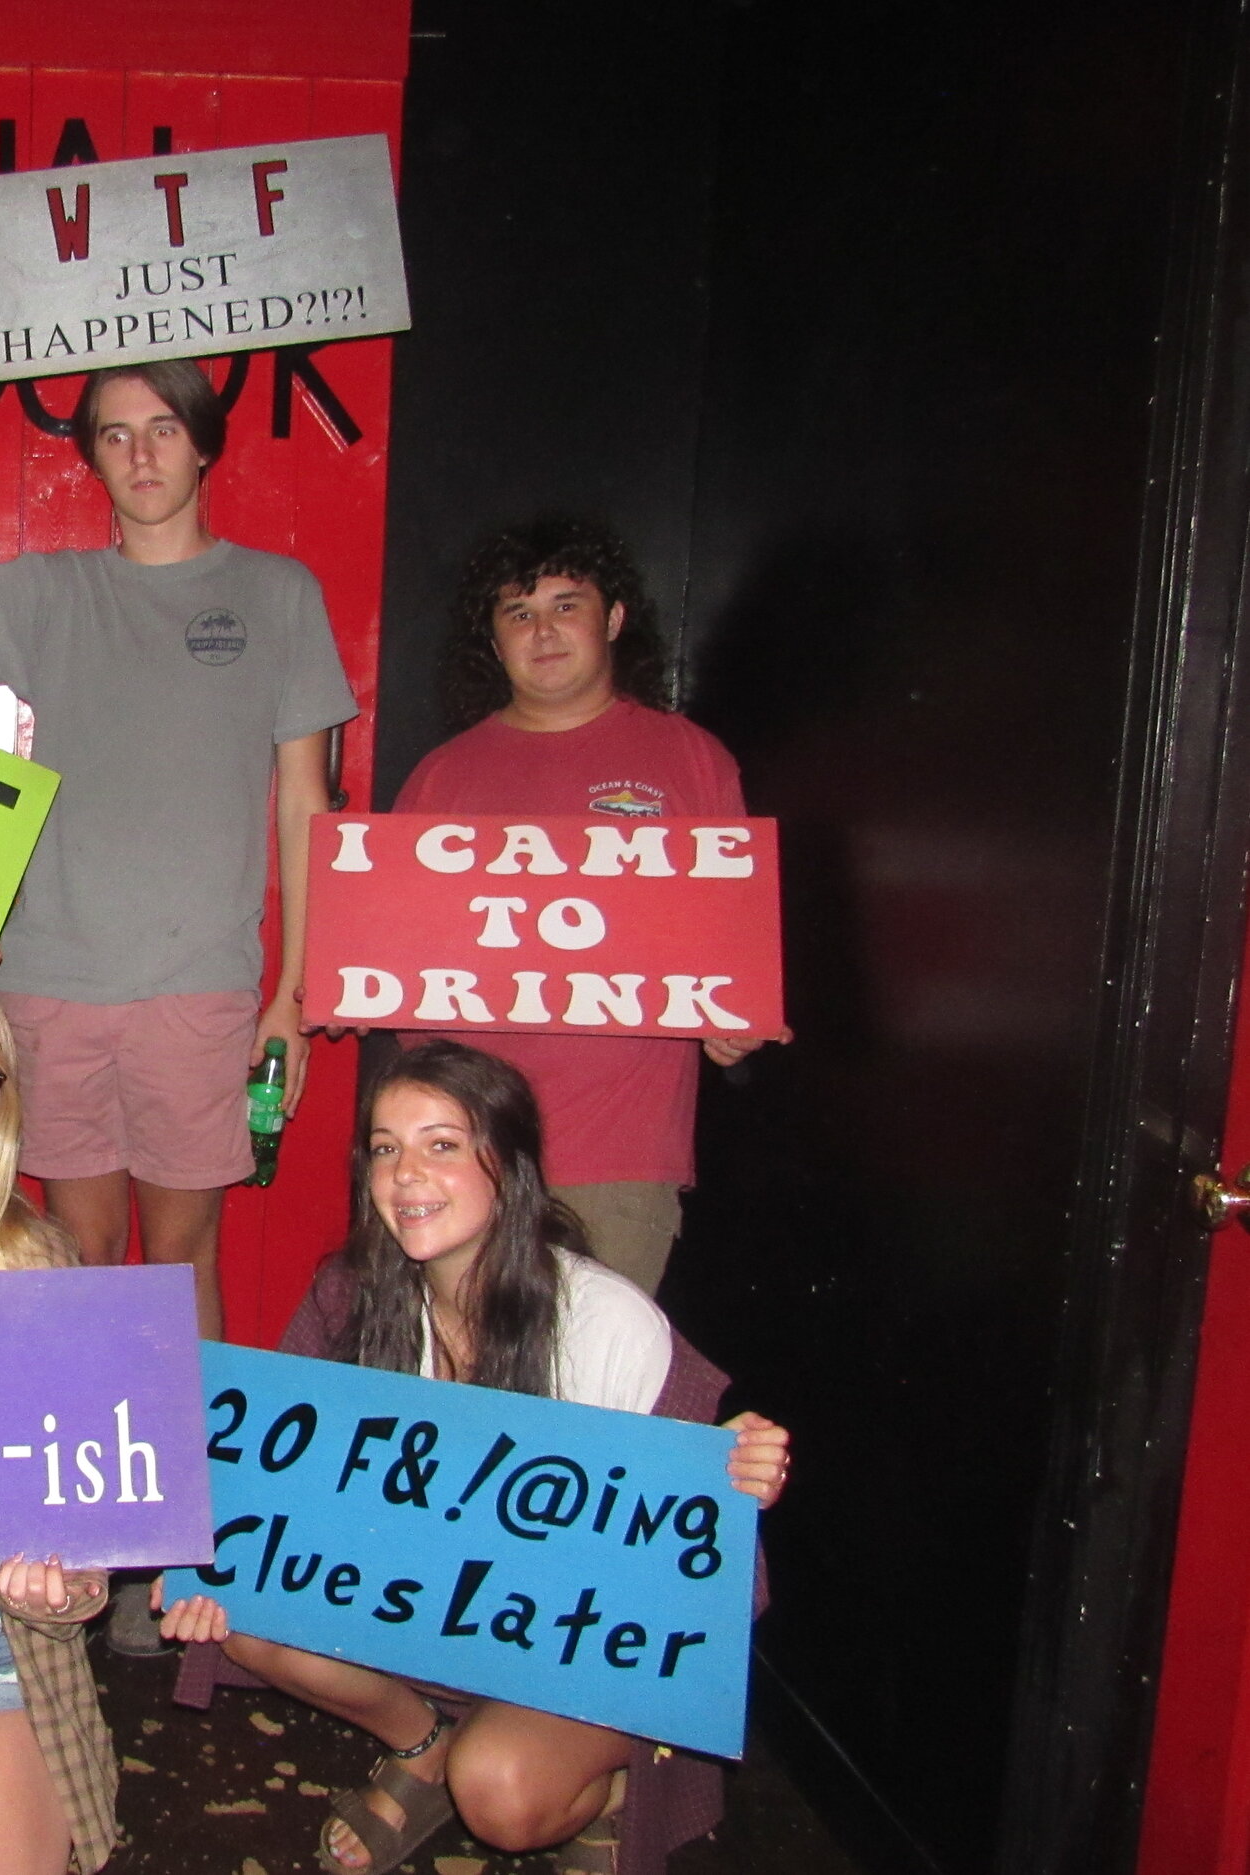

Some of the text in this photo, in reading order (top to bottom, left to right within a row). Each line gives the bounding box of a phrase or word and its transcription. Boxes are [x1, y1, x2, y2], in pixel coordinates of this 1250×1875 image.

[115, 252, 239, 301] JUST
[1, 285, 368, 364] HAPPENED?!?!
[588, 780, 665, 799] OCEAN & COAST
[330, 822, 754, 879] I CAME
[468, 895, 606, 950] TO
[333, 966, 751, 1031] DRINK
[206, 1387, 318, 1473] 20
[196, 1512, 708, 1679] Clues Later
